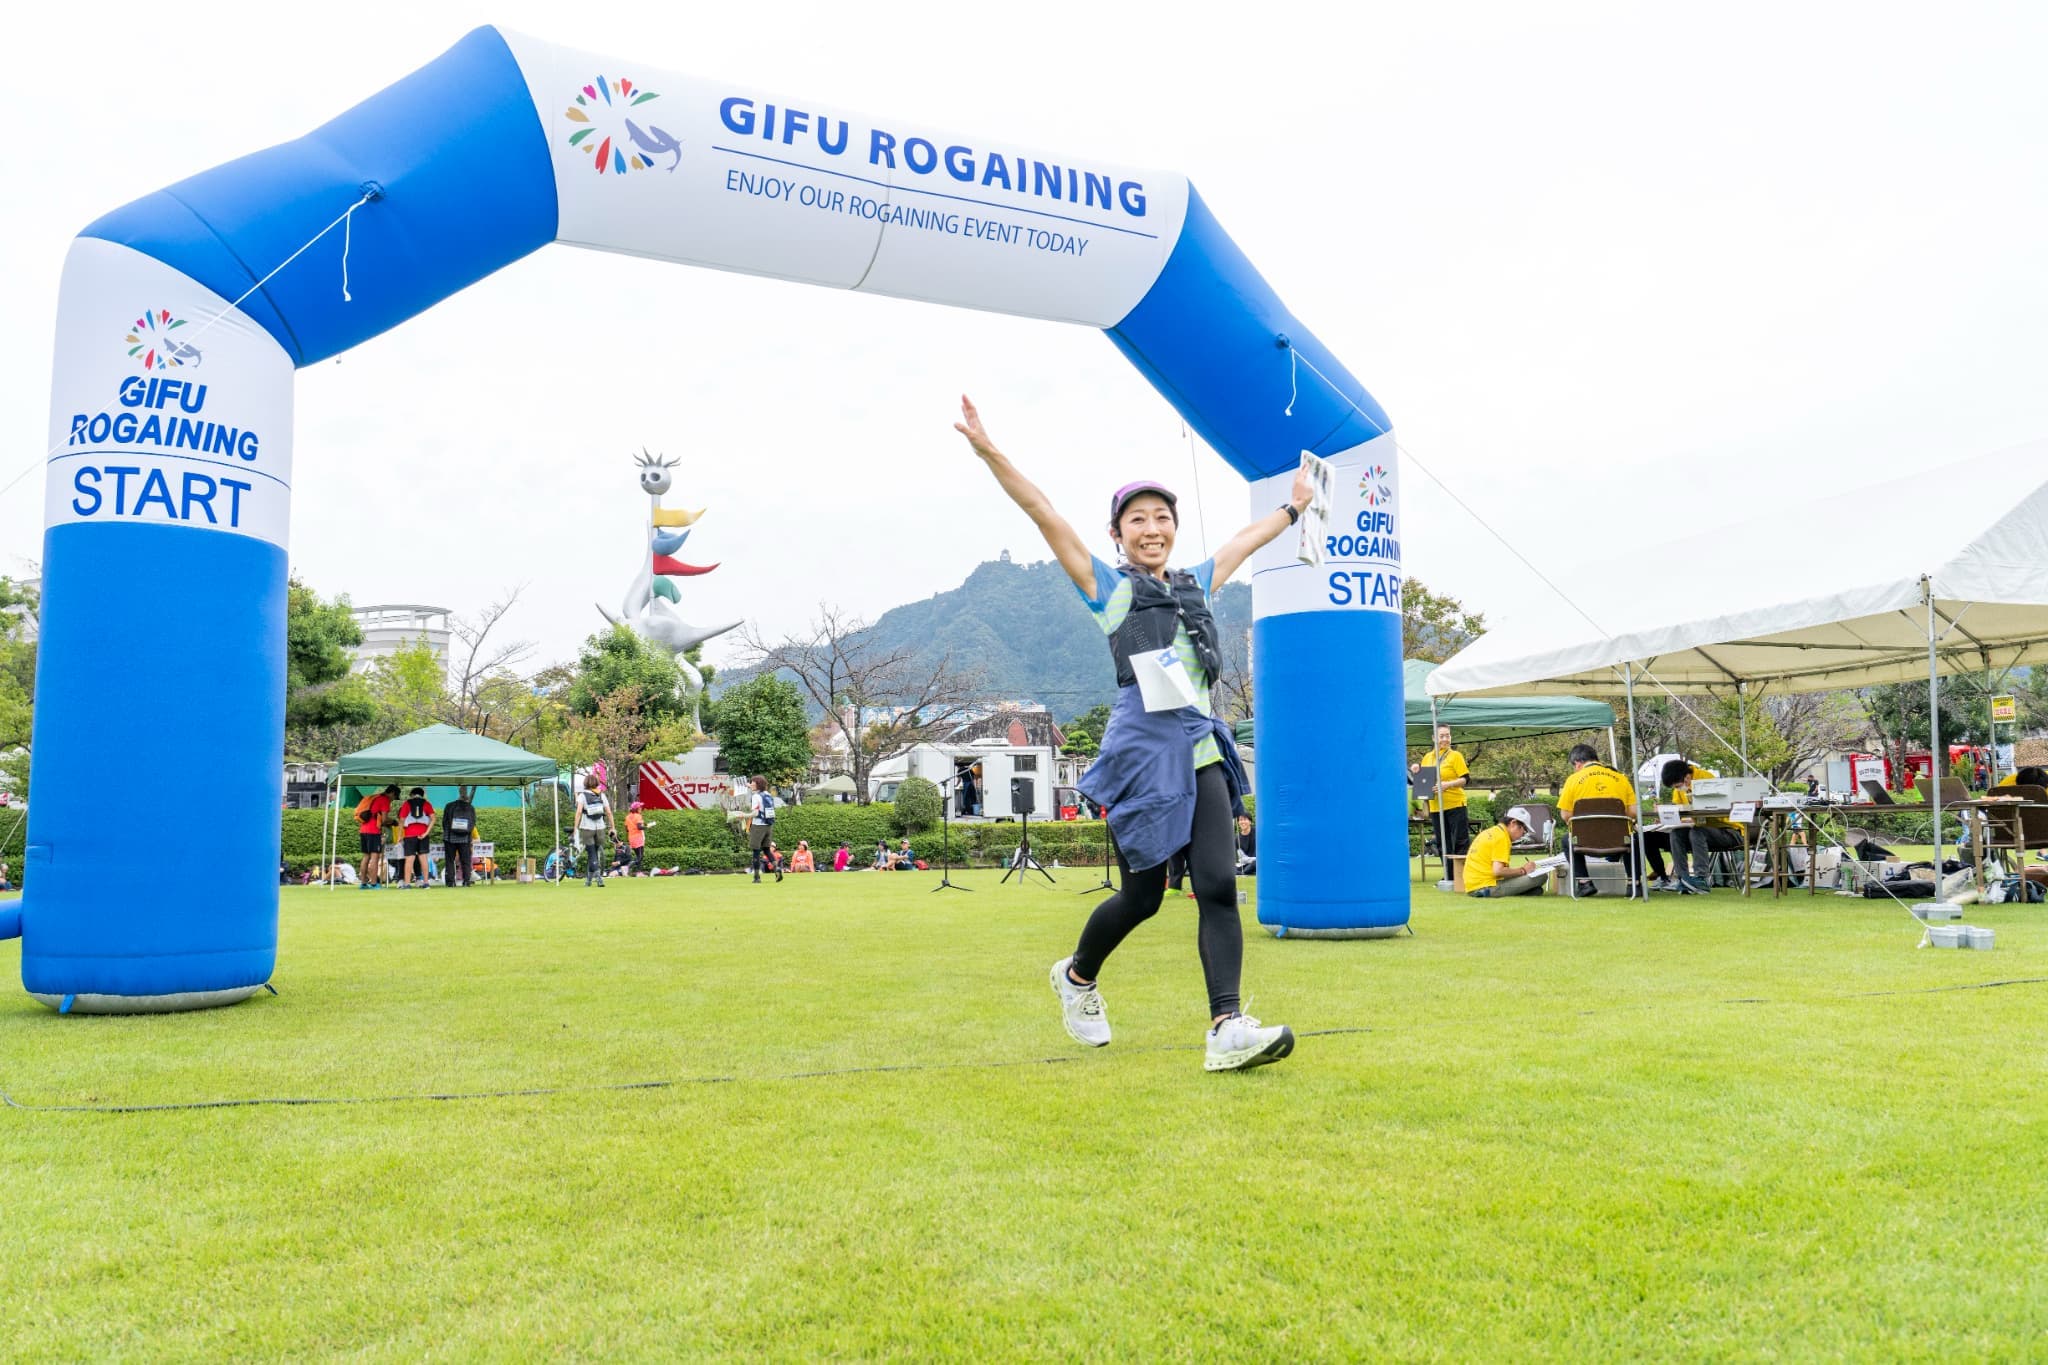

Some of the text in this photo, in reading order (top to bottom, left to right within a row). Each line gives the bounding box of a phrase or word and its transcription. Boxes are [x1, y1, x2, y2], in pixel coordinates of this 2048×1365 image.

[719, 96, 1148, 219] GIFU ROGAINING
[725, 169, 1089, 257] ENJOY OUR ROGAINING EVENT TODAY
[118, 375, 209, 414] GIFU
[69, 411, 260, 462] ROGAINING
[71, 464, 253, 529] START
[1356, 510, 1395, 535] GIFU
[1326, 535, 1401, 563] ROGAININ
[1328, 570, 1402, 608] STAR
